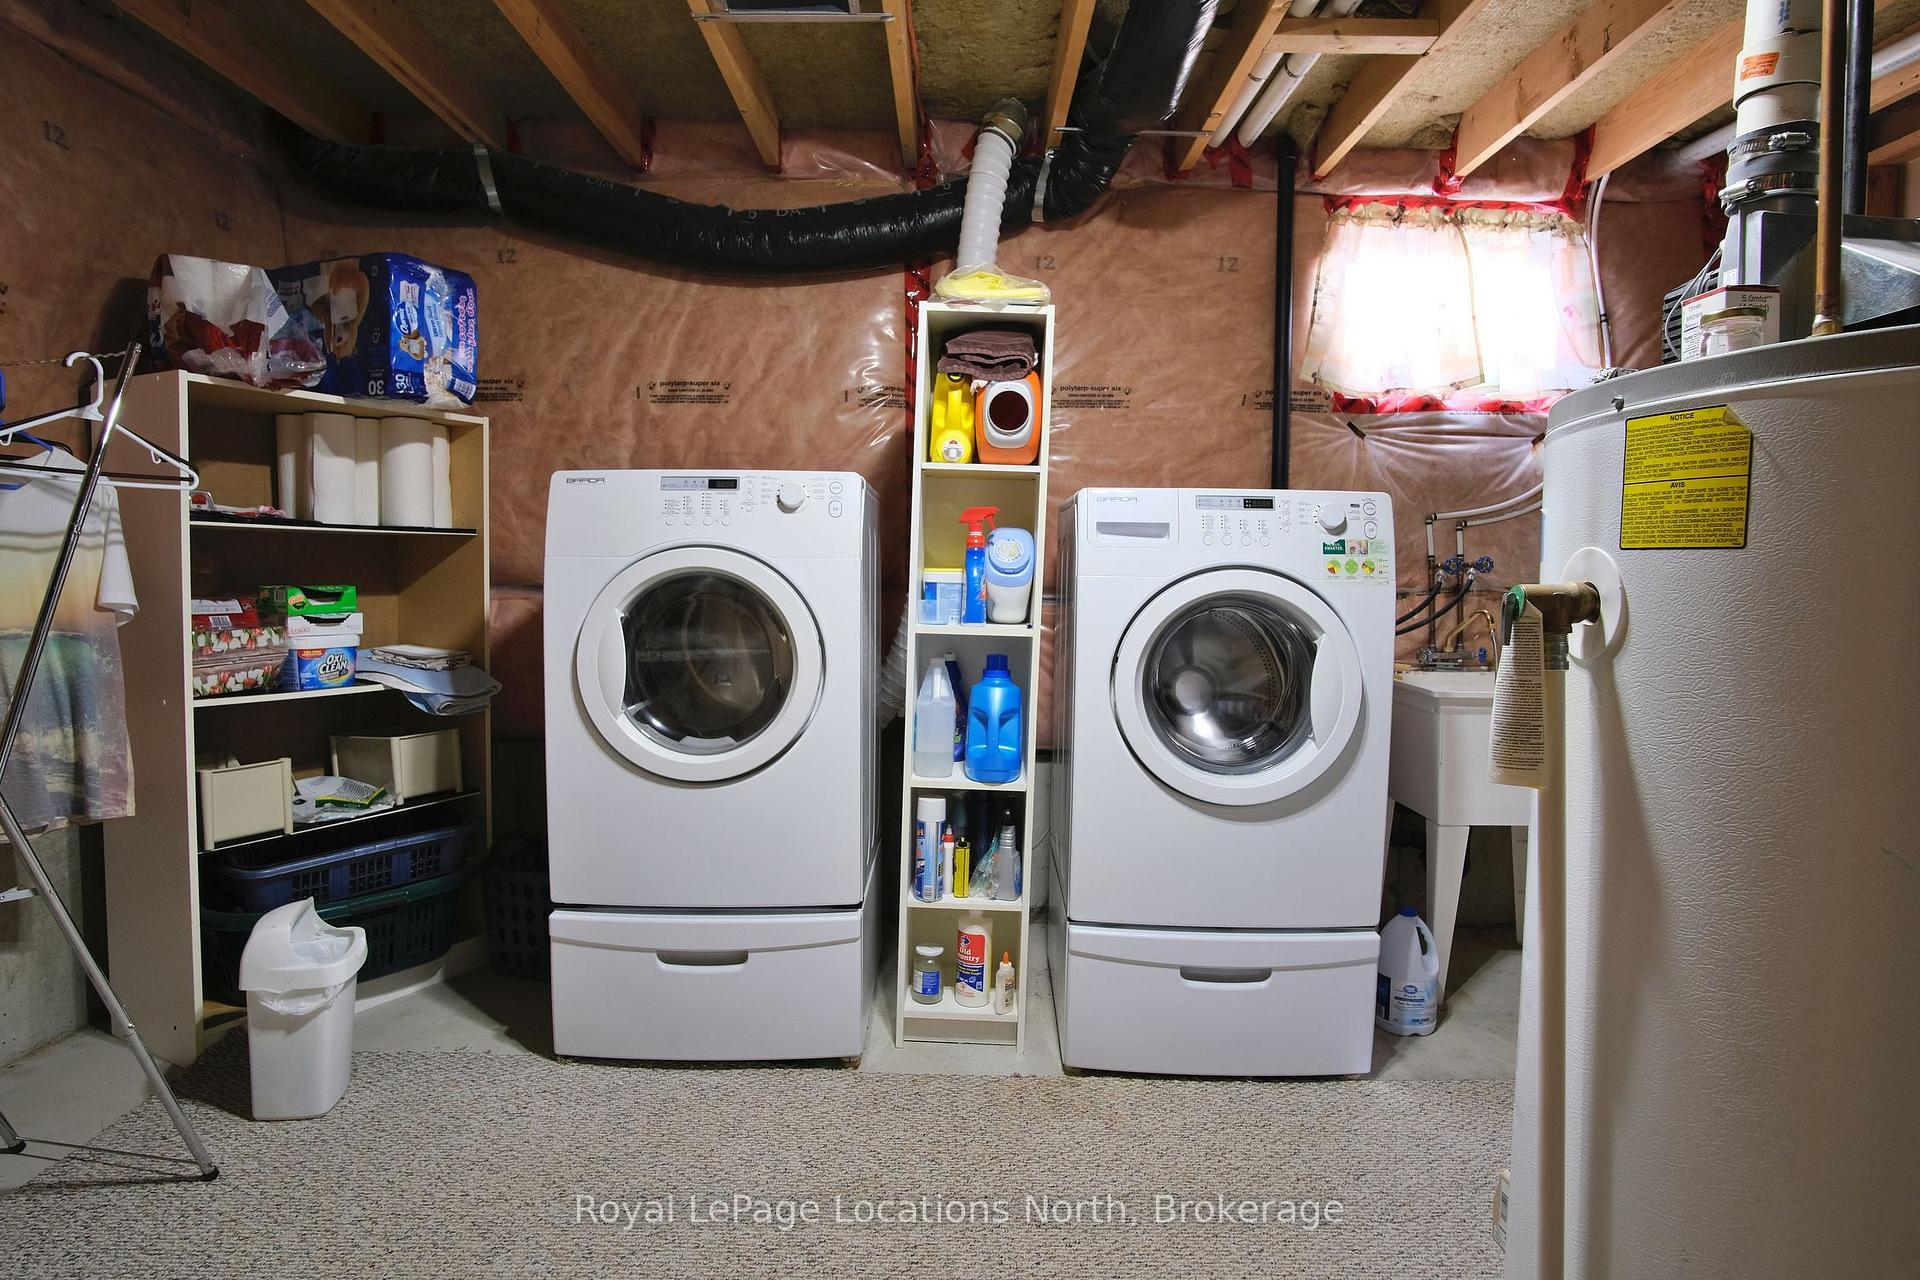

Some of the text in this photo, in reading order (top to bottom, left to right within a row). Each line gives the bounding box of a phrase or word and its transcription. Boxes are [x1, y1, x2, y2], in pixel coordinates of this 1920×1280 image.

[42, 119, 70, 151] 12
[496, 249, 517, 264] 12
[1035, 254, 1056, 270] 12
[1216, 256, 1239, 272] 12
[1669, 412, 1695, 422] NOTICE
[319, 659, 348, 675] CLEAN
[325, 653, 344, 666] OXI
[959, 946, 972, 956] Old
